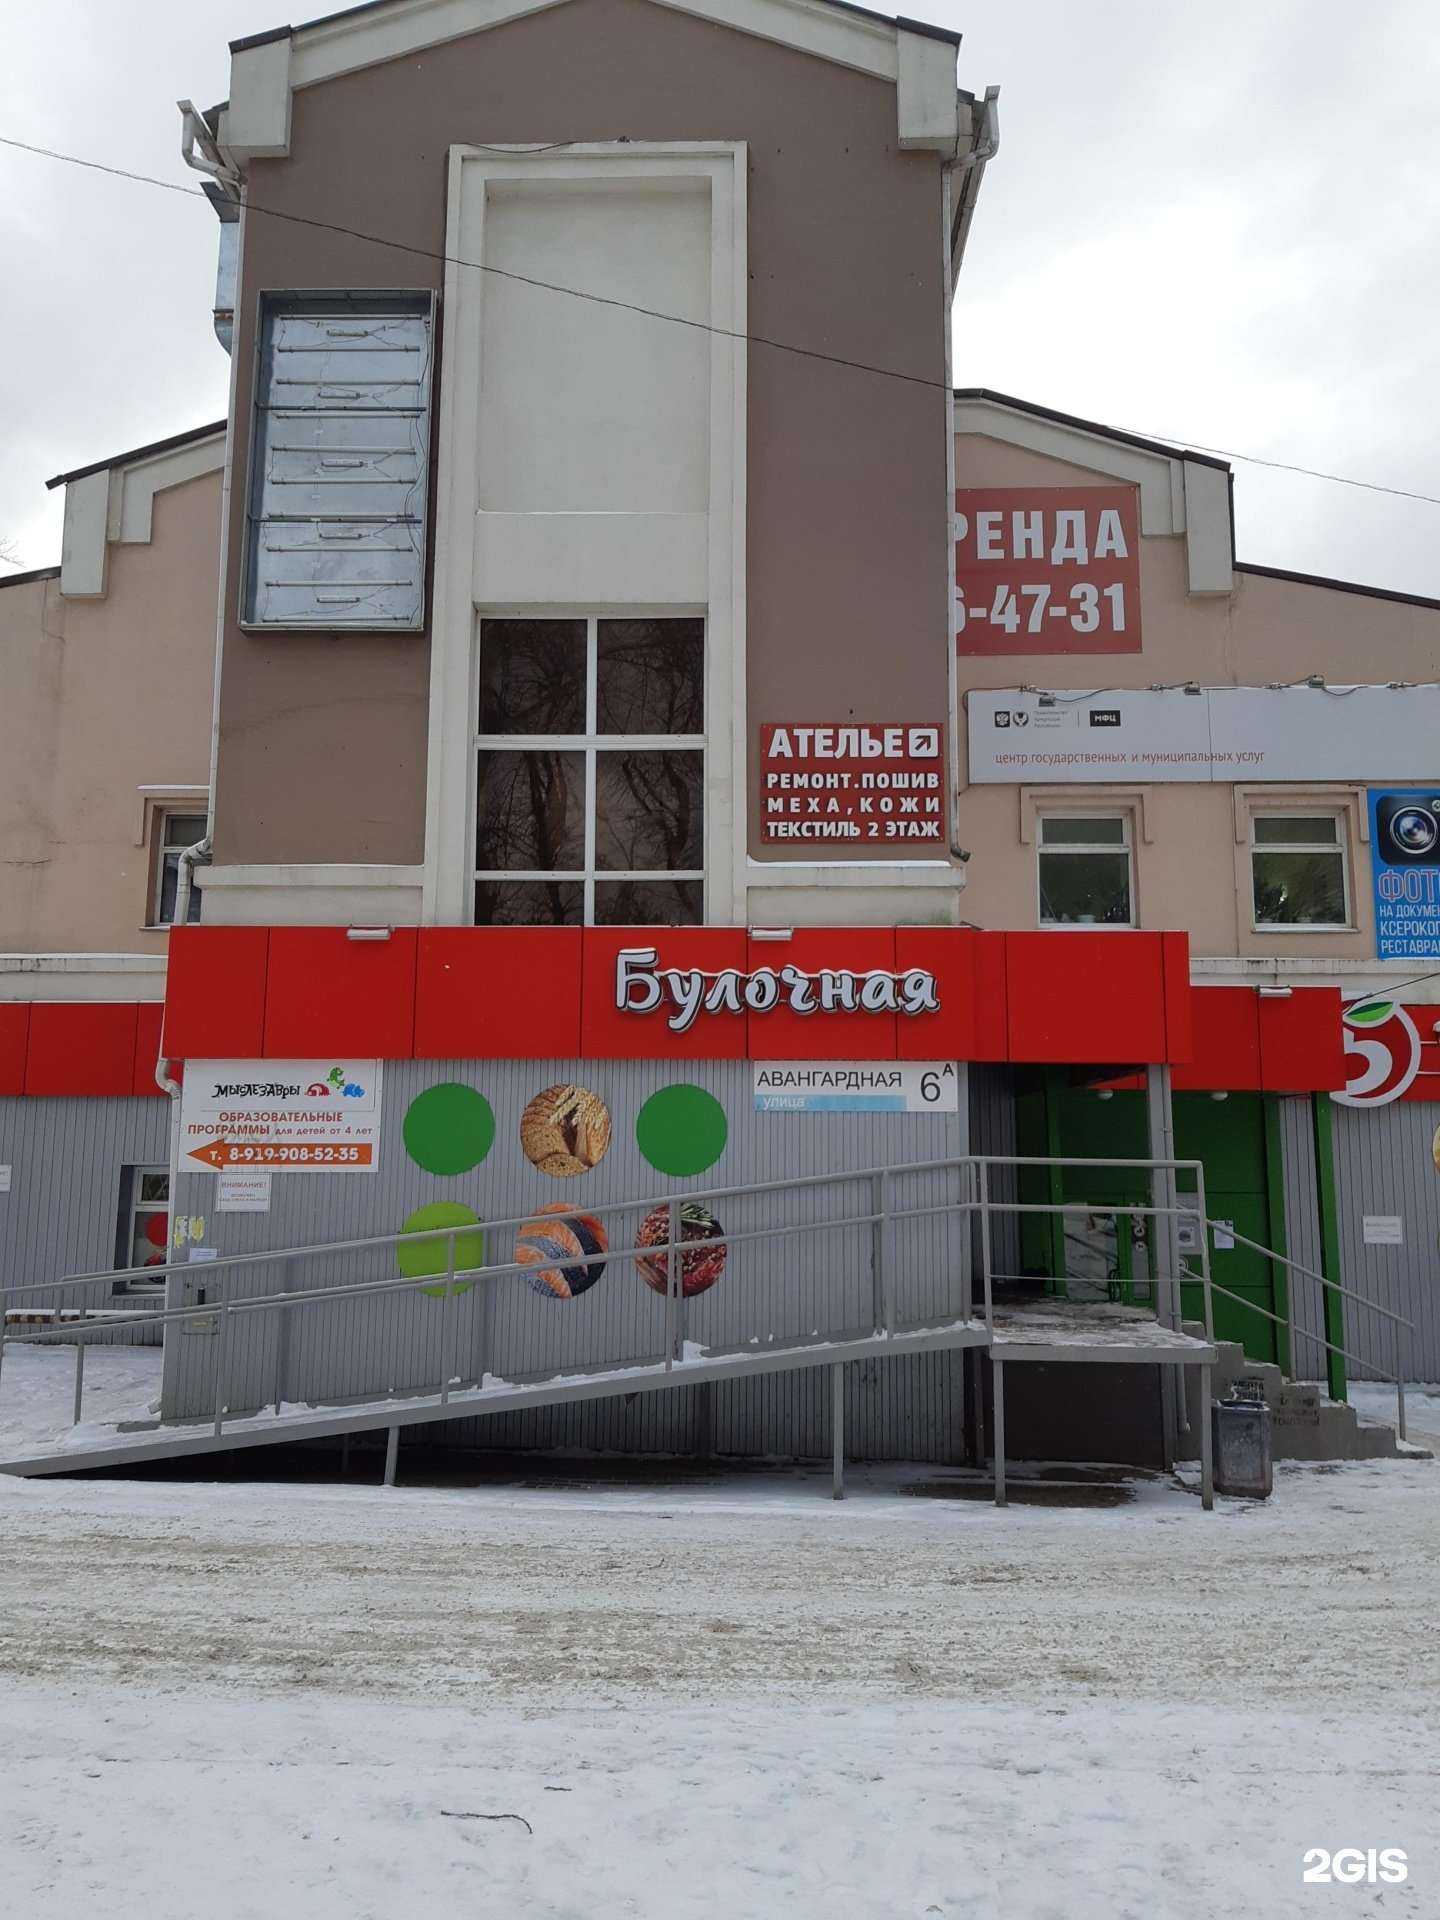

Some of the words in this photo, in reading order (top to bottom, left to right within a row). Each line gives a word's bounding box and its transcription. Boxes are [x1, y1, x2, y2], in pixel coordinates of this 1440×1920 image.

[1094, 714, 1117, 723] МФЦ
[768, 728, 904, 759] АТЕЛЬЕ
[995, 753, 1028, 767] центр
[1031, 751, 1126, 765] государственных
[1132, 753, 1138, 761] и
[1142, 751, 1233, 765] муниципальных
[1236, 751, 1265, 765] услуг
[767, 797, 853, 815] МЕХА,
[860, 797, 939, 813] КОЖИ
[767, 821, 860, 837] ТЕКСТИЛЬ
[868, 822, 878, 836] 2
[885, 821, 940, 837] ЭТАЖ
[1379, 869, 1440, 903] ФОТ
[1380, 904, 1393, 917] НА
[1381, 939, 1440, 954] РЕСТАВРА
[615, 947, 940, 1032] Булочная
[757, 1071, 902, 1090] АВАНГАРДНАЯ
[763, 1097, 805, 1110] улица
[219, 1112, 343, 1122] ОБРАЗОВАТЕЛЬНЫЕ
[188, 1125, 270, 1135] ПРОГРАММЫ
[296, 1127, 326, 1136] детей
[345, 1127, 352, 1135] 4
[209, 1150, 222, 1161] т.
[229, 1147, 359, 1161] 8-919-908-52-35
